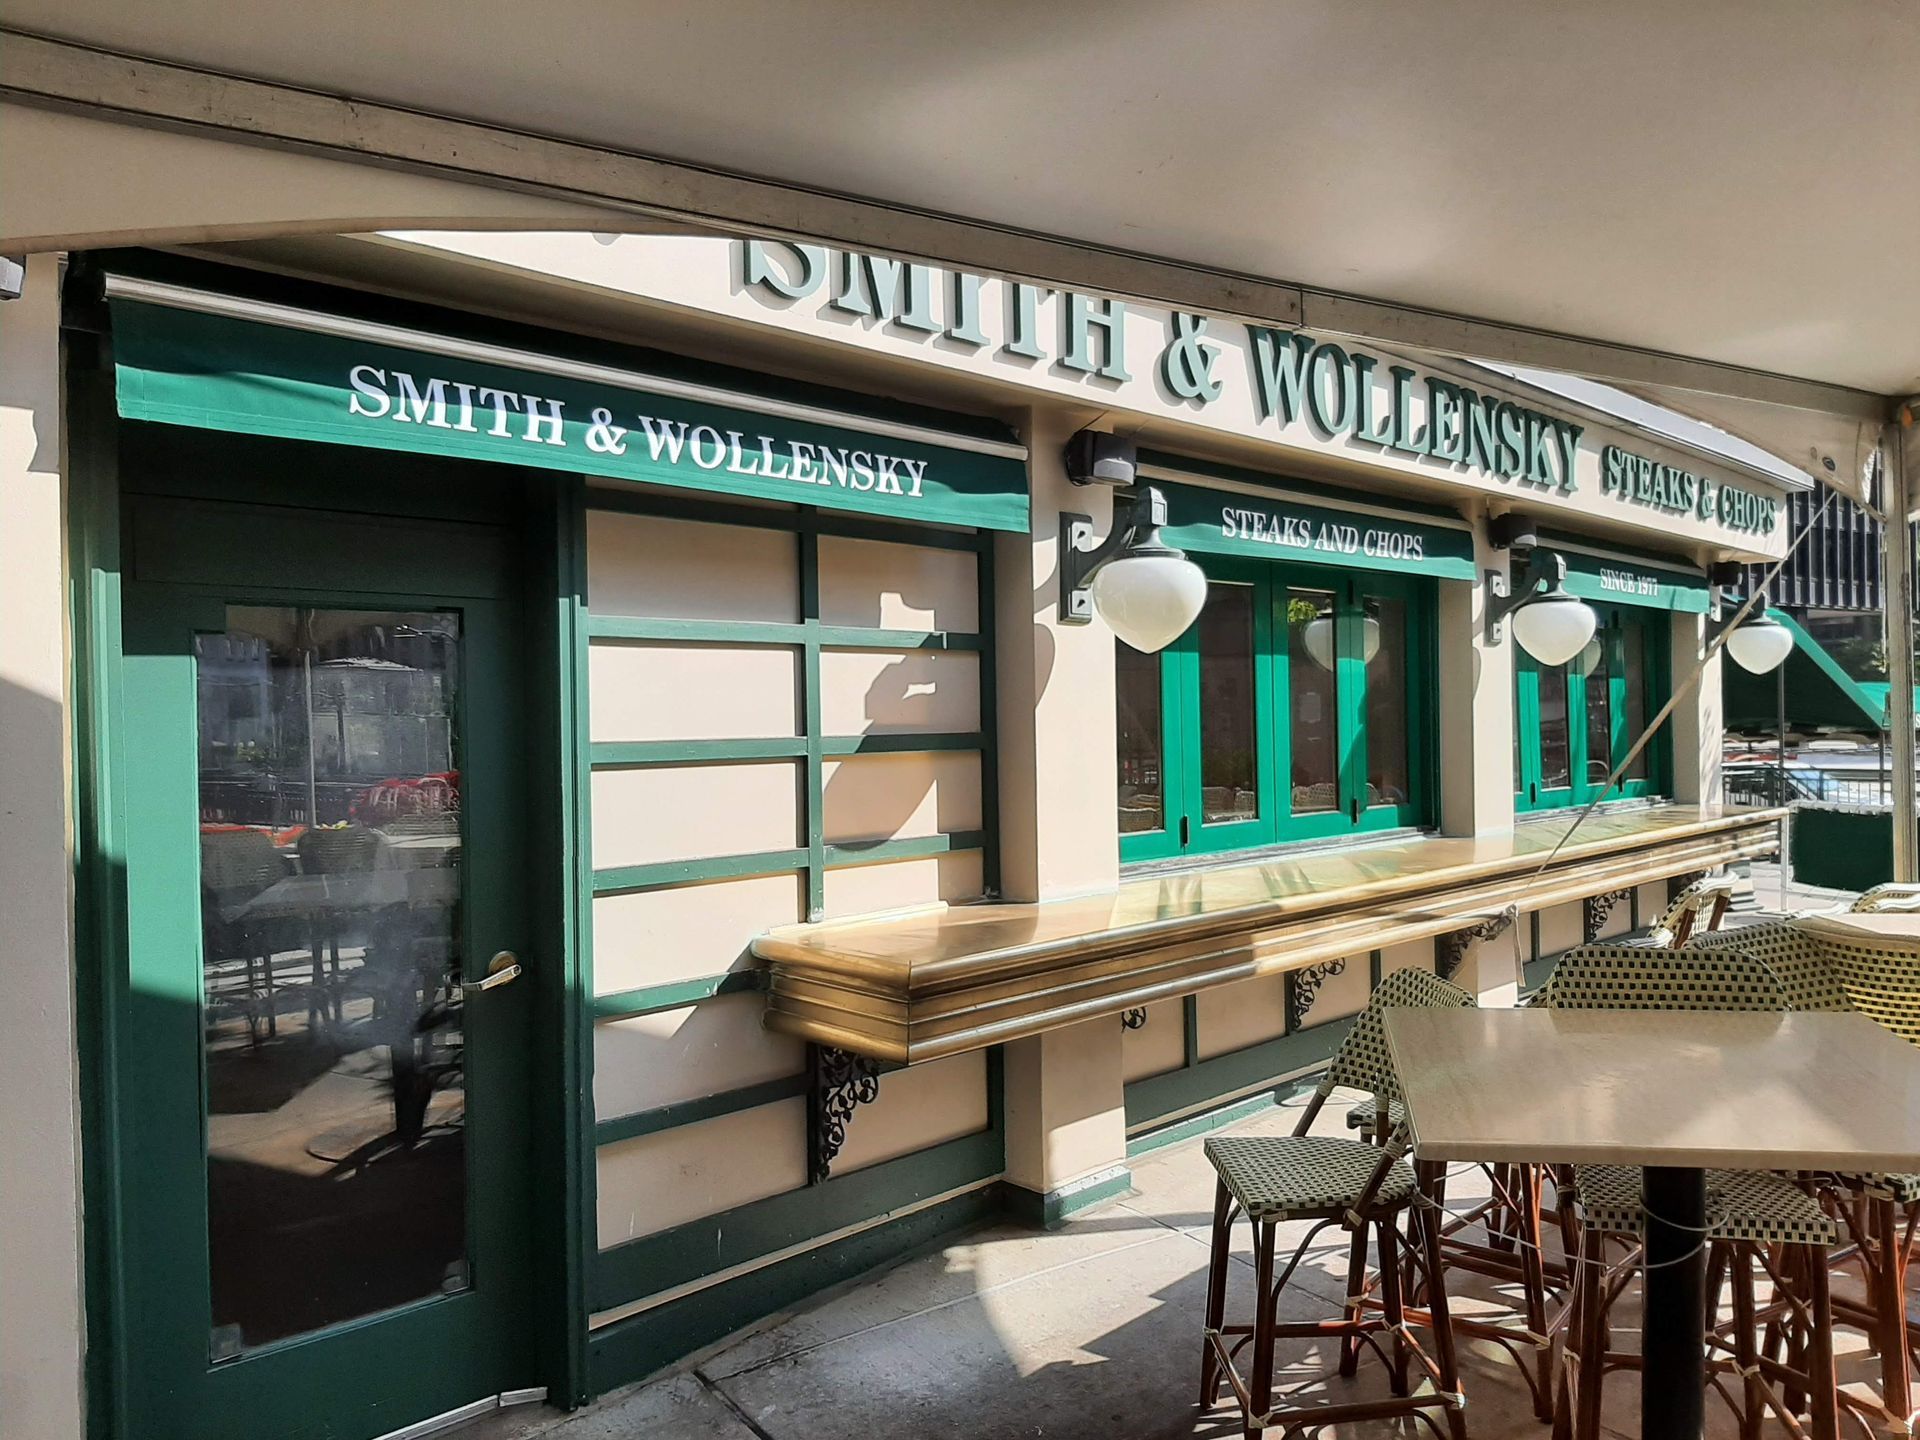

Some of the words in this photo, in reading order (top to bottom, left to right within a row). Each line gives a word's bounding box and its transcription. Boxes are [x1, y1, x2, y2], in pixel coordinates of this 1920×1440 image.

[744, 240, 1132, 382] SMITH
[1161, 311, 1223, 402] &
[1245, 324, 1584, 493] WOLLENSKY
[348, 364, 567, 447] SMITH
[585, 407, 627, 455] &
[638, 415, 928, 498] WOLLENSKY
[1602, 445, 1694, 513] STEAKS
[1700, 478, 1714, 518] &
[1719, 484, 1776, 533] CHOPS
[1221, 507, 1311, 549] STEAKS
[1314, 521, 1359, 555] AND
[1363, 528, 1424, 562] CHOPS
[1600, 568, 1635, 594] SINCE
[1637, 575, 1658, 597] 1977
